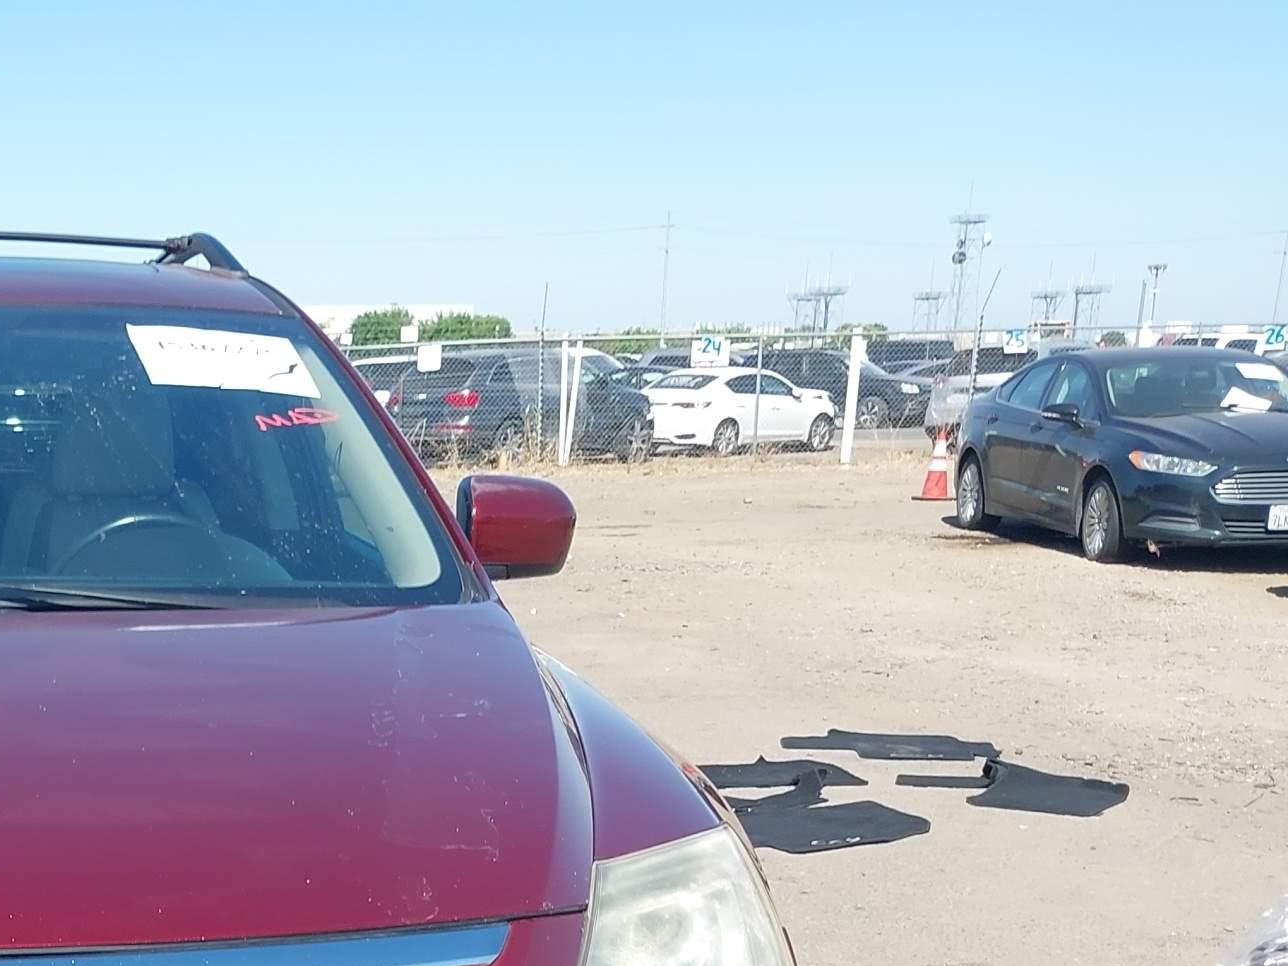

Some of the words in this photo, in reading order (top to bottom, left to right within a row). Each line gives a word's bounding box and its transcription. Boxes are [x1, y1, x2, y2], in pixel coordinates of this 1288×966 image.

[1005, 327, 1024, 348] 25
[1264, 324, 1287, 344] 26
[702, 337, 721, 357] 24
